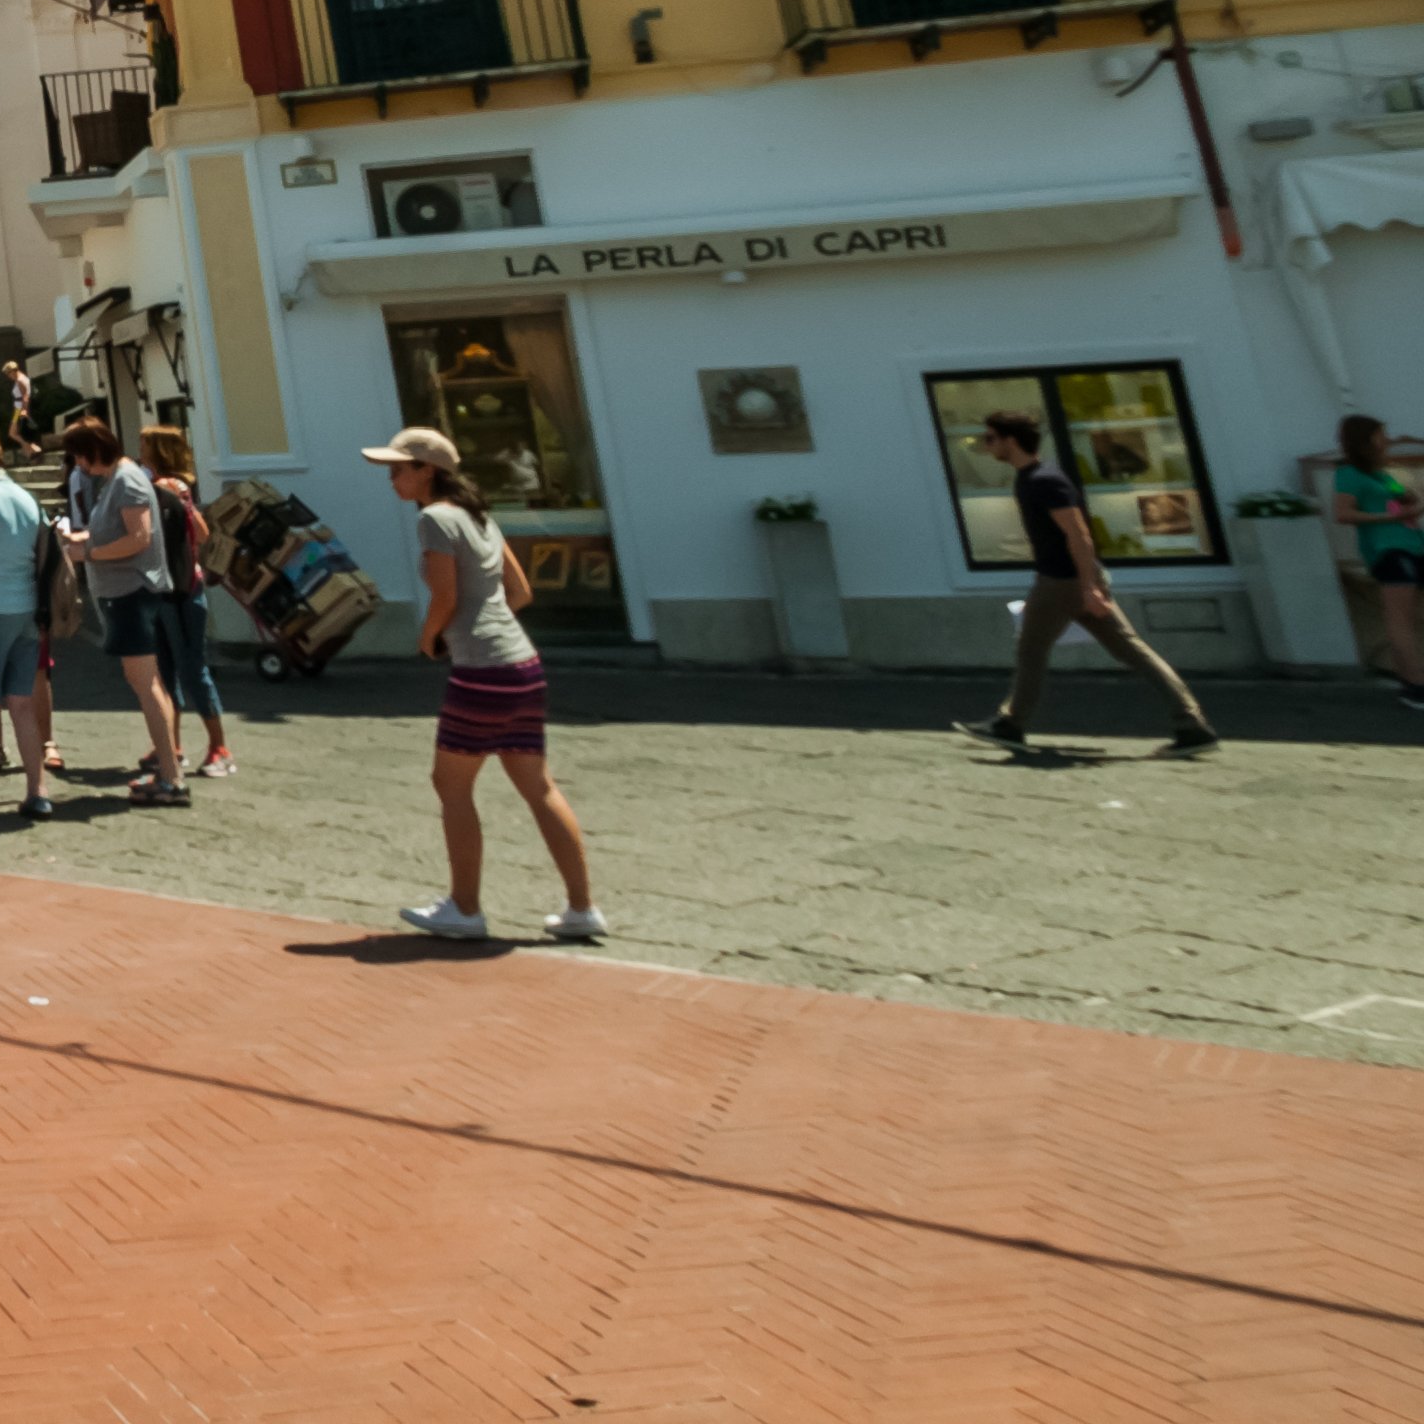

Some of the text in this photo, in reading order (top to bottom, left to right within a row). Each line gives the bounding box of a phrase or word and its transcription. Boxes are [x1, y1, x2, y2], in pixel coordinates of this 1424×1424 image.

[504, 222, 949, 278] LA PERLA DI CAPRI
